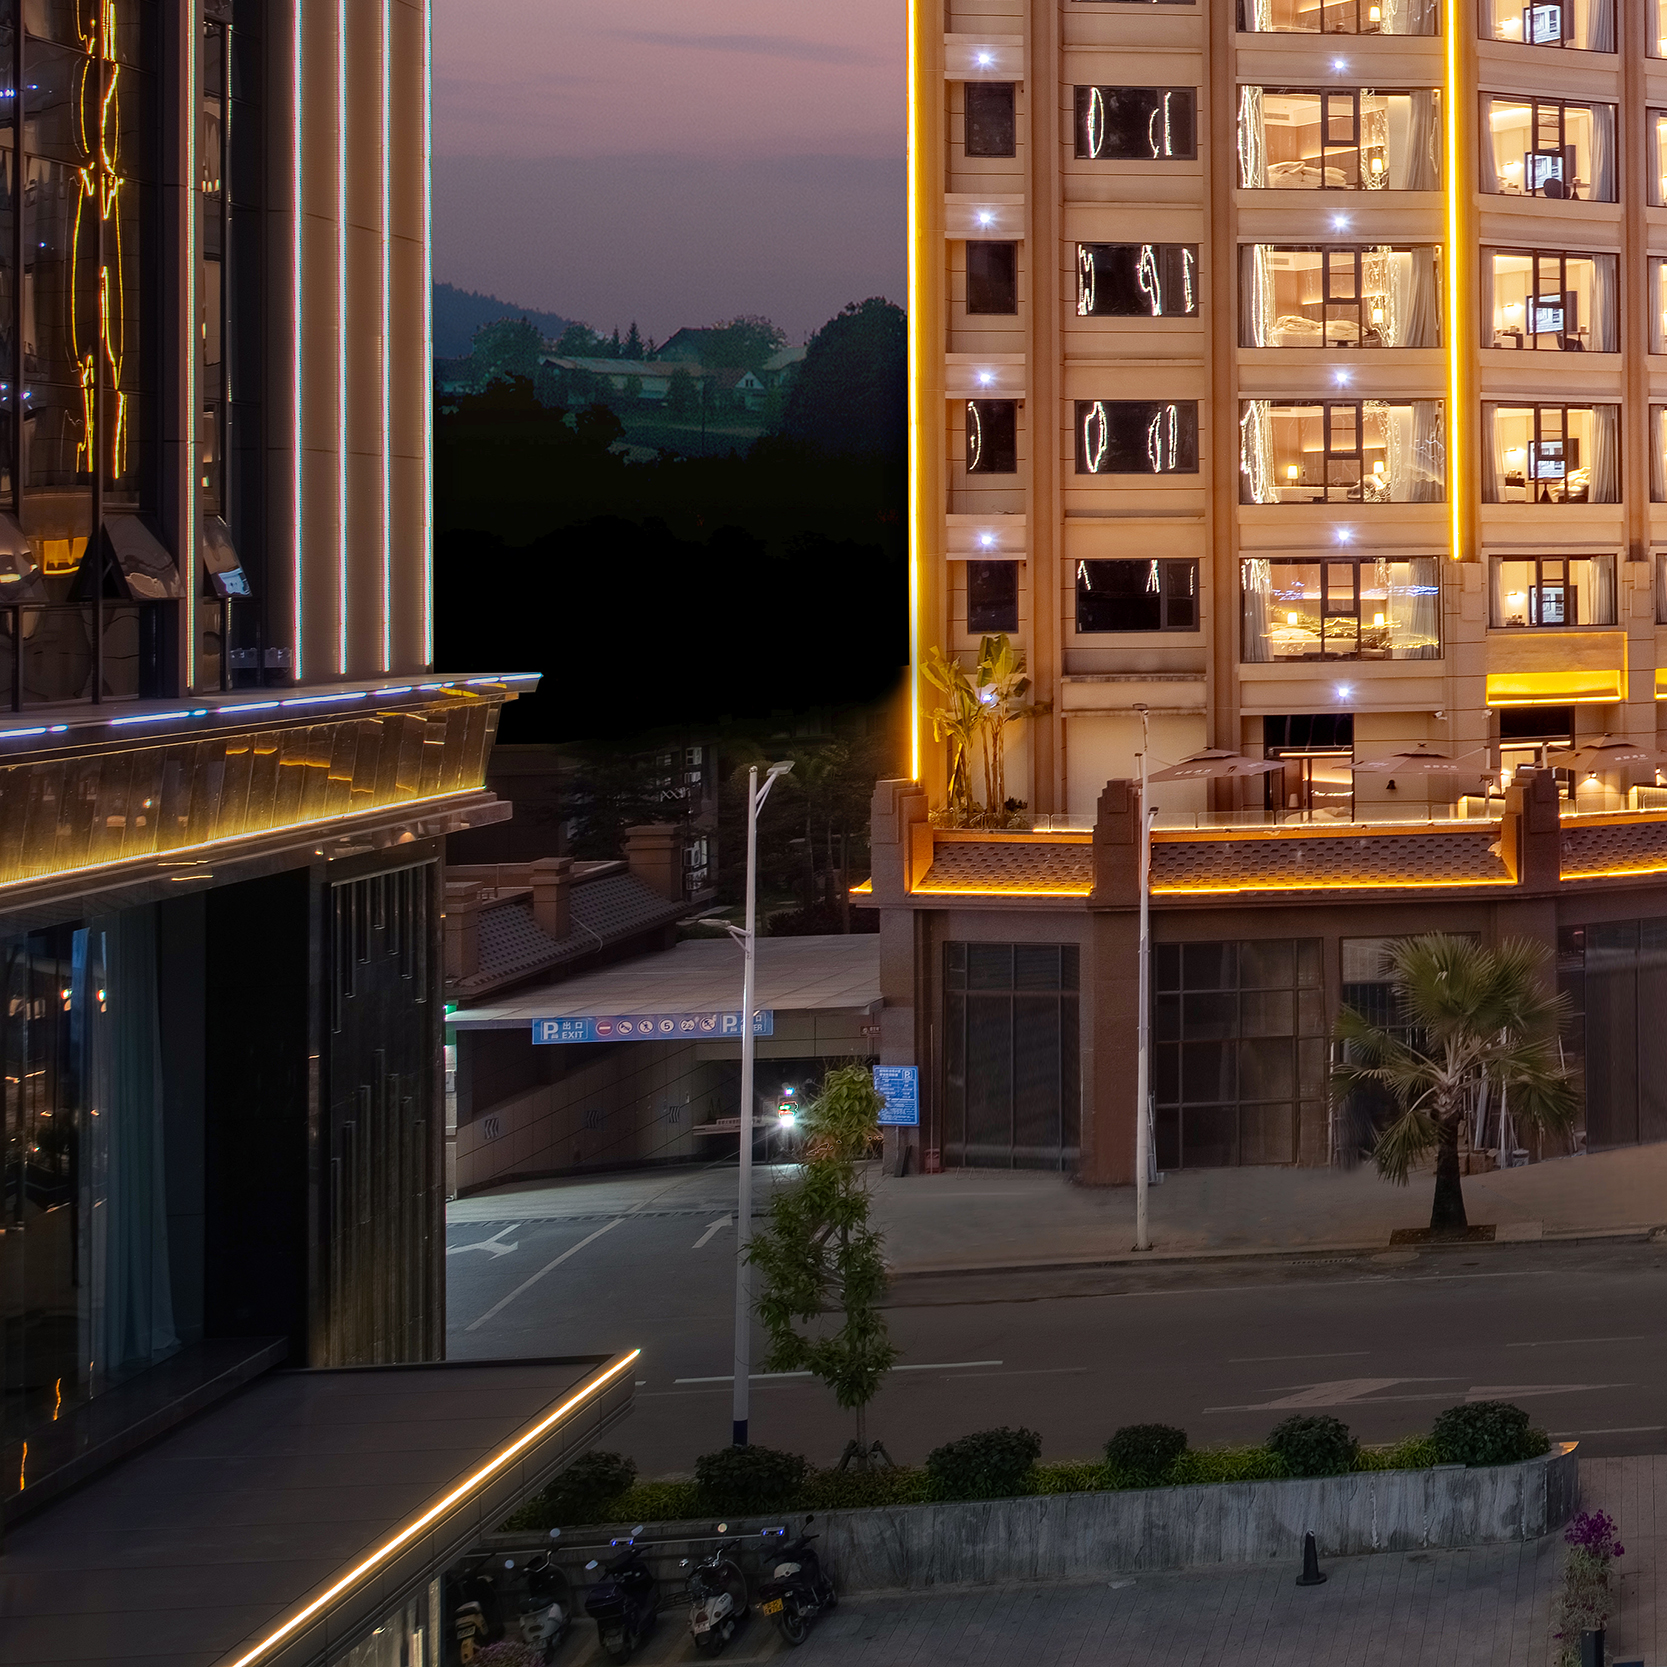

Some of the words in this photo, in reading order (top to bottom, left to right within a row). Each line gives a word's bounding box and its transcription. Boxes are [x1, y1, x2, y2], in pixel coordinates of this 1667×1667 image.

[562, 1021, 583, 1030] 出口
[664, 1022, 671, 1030] 5
[722, 1015, 738, 1033] P
[543, 1021, 559, 1040] P
[562, 1031, 584, 1039] EXIT
